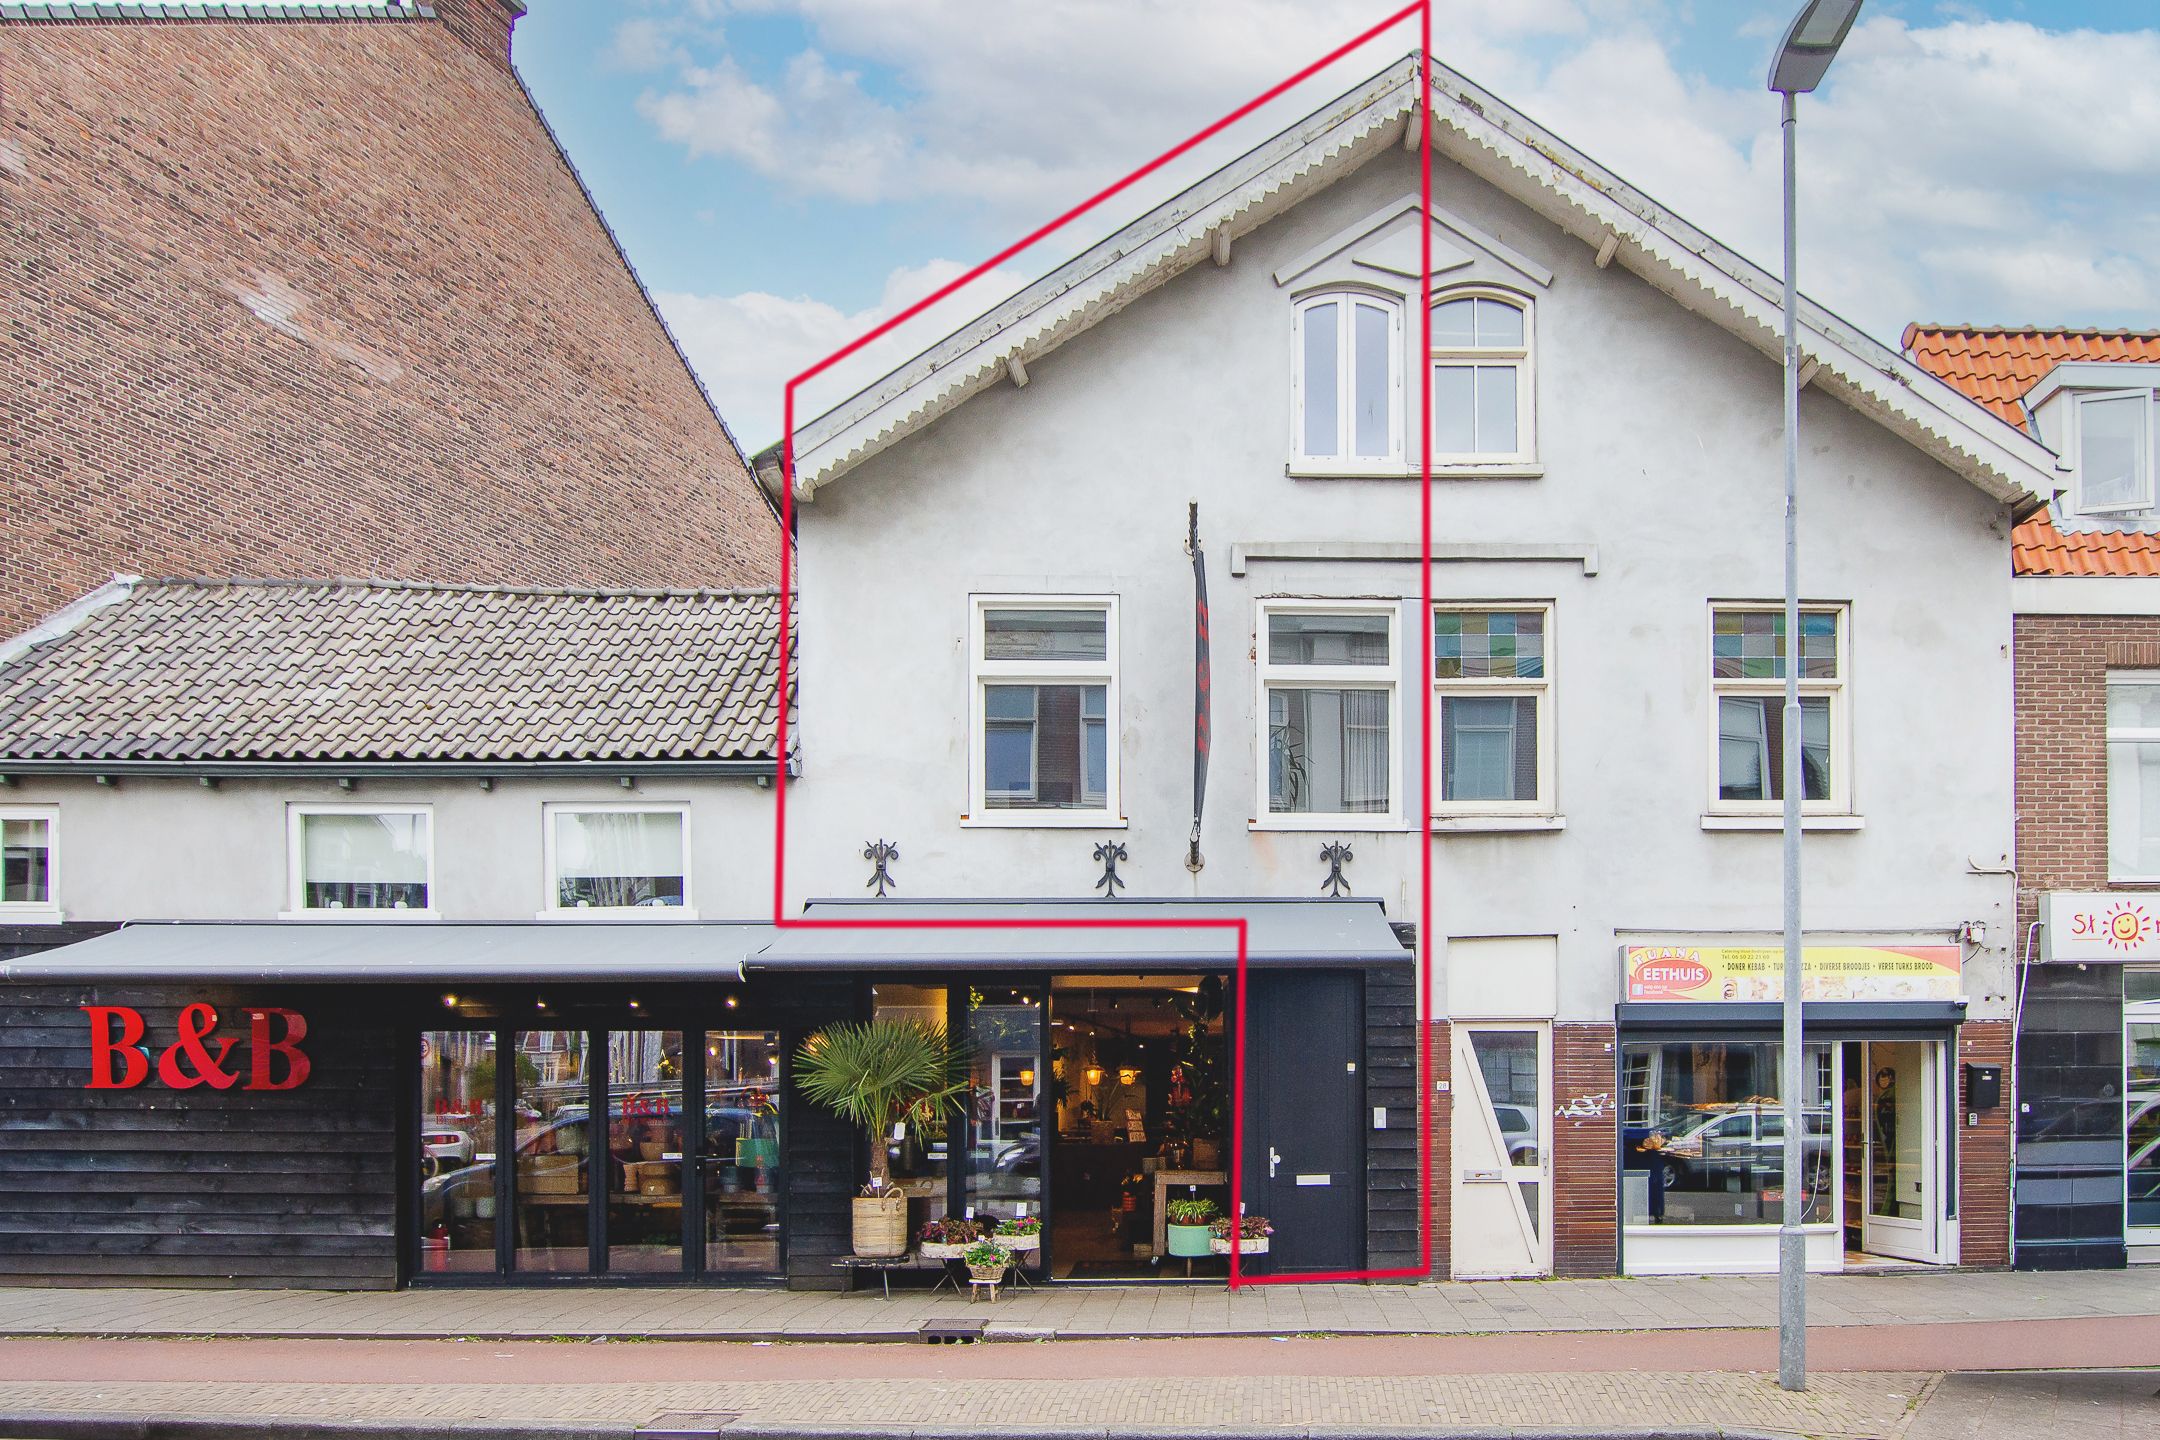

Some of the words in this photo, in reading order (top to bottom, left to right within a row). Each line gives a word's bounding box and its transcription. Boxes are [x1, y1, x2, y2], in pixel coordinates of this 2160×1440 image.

[1632, 947, 1700, 966] TUANA
[1643, 967, 1705, 981] EETHUIS
[1727, 963, 1745, 971] DONER
[1748, 963, 1765, 971] KEBAB
[1878, 962, 1894, 970] VERSE
[1896, 962, 1912, 970] TURKS
[1914, 962, 1933, 970] BROOD
[80, 1003, 311, 1091] B&B
